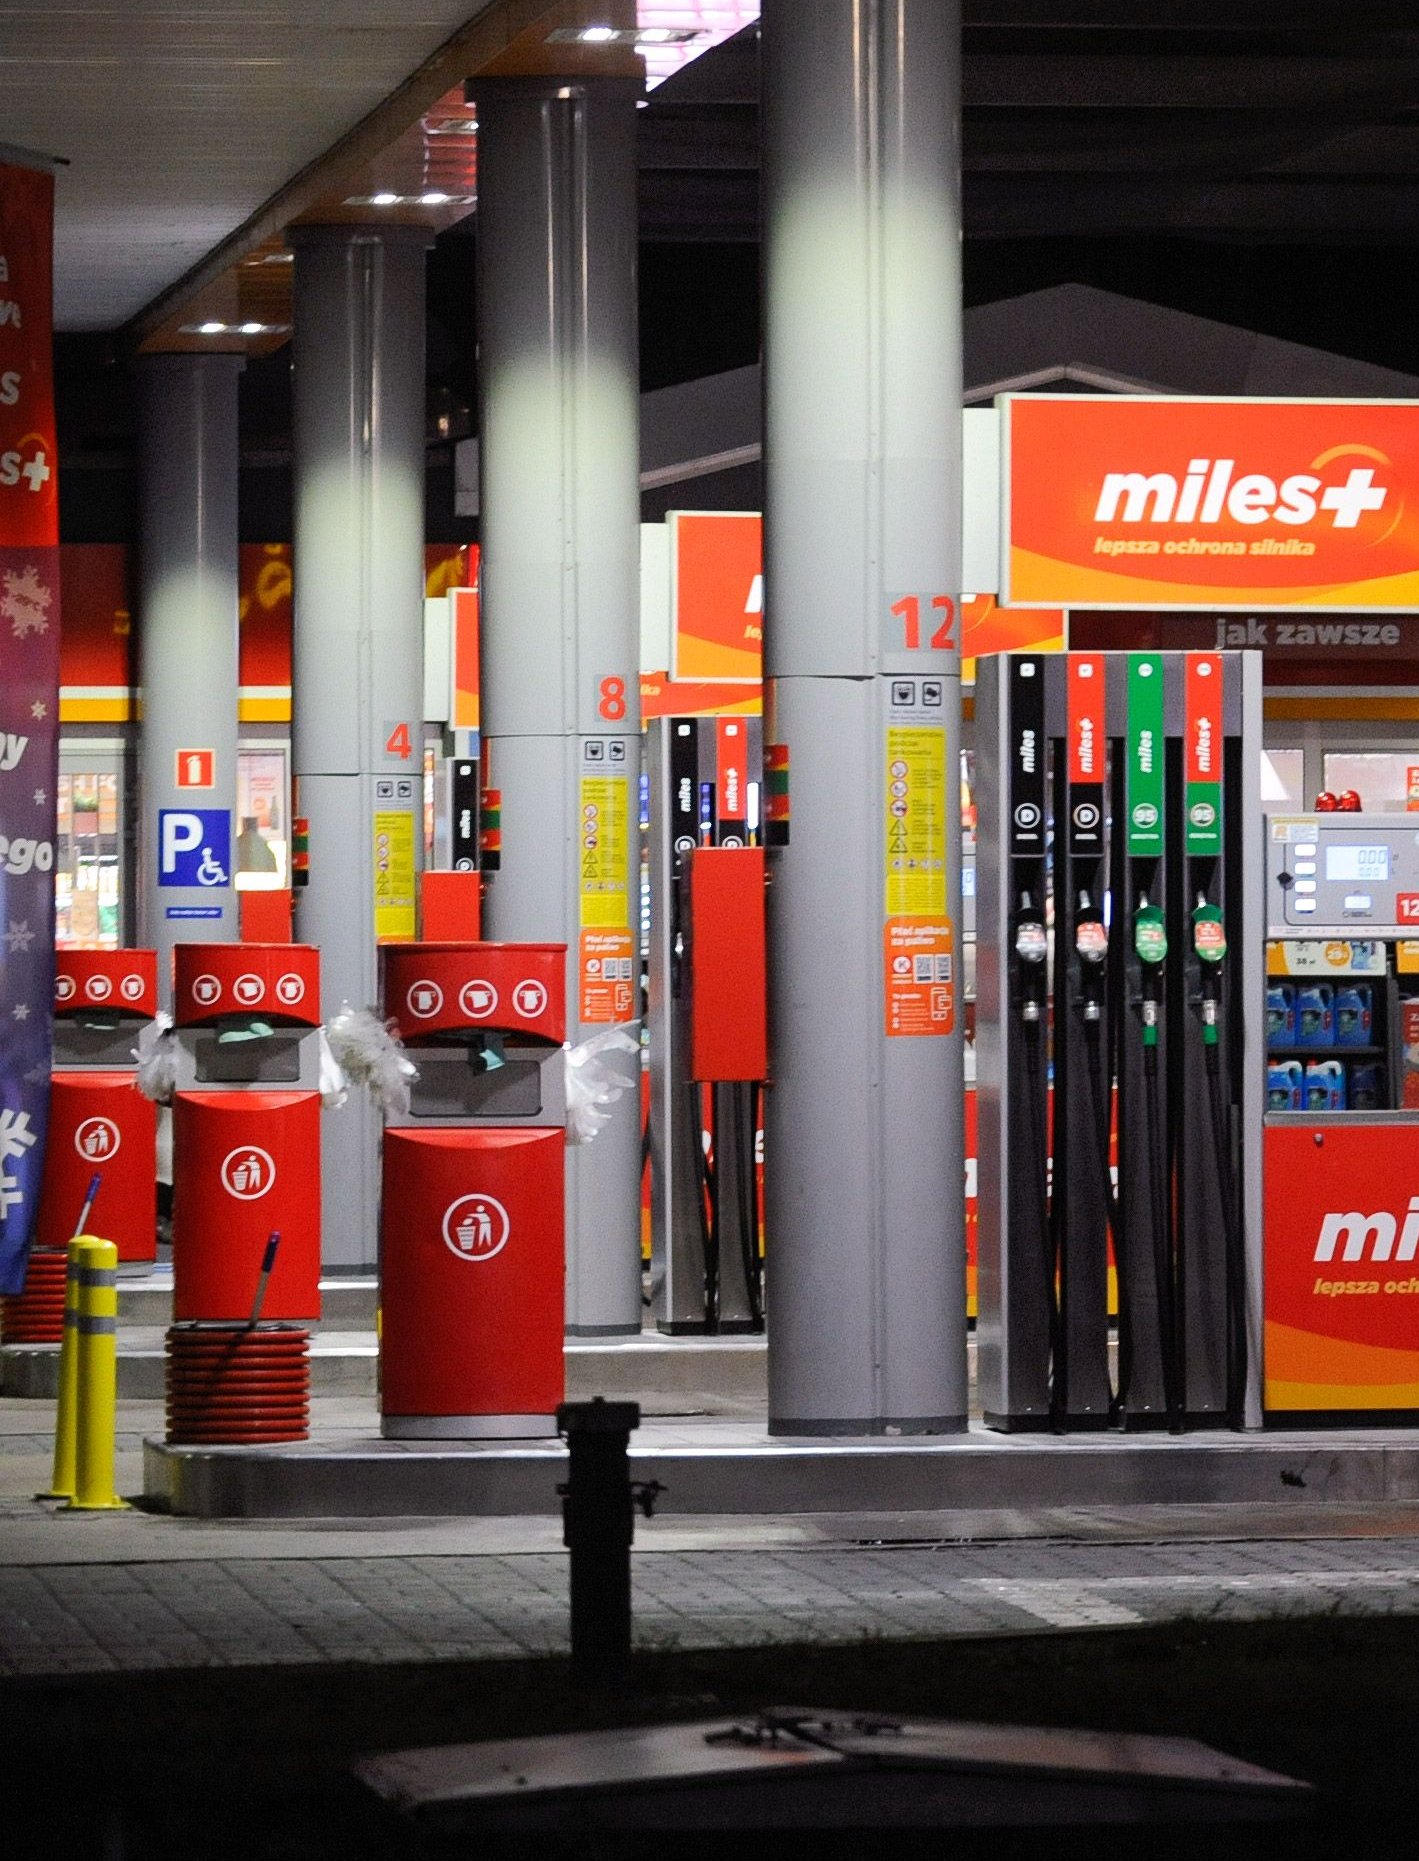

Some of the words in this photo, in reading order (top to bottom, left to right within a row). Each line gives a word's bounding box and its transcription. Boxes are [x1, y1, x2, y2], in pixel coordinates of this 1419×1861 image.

[1095, 459, 1387, 527] miles+
[1094, 536, 1159, 556] lepsza
[1165, 537, 1245, 555] ochrona
[1250, 538, 1315, 556] silnika
[890, 595, 955, 650] 12
[1215, 618, 1269, 652] jak
[1276, 620, 1399, 645] zawsze
[598, 676, 625, 720] 8
[386, 722, 412, 760] 4
[1020, 730, 1035, 773] miles
[1138, 730, 1152, 773] miles
[163, 813, 204, 873] P
[1313, 1278, 1379, 1297] lepsza
